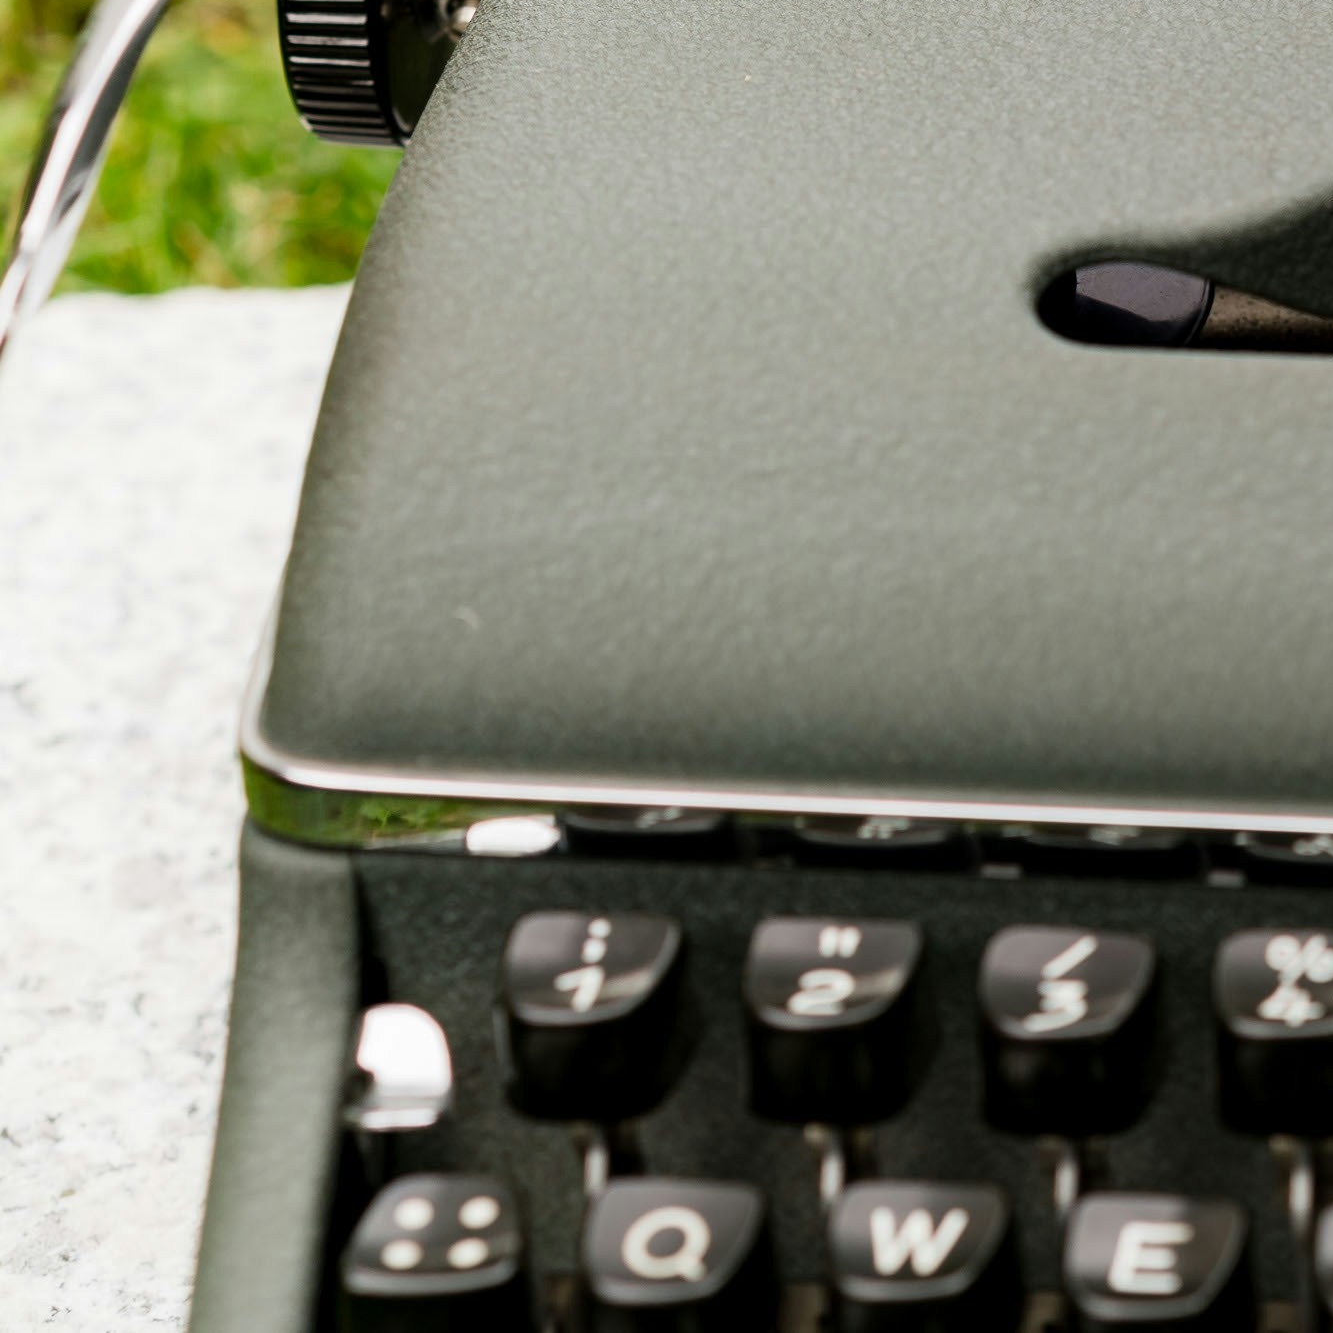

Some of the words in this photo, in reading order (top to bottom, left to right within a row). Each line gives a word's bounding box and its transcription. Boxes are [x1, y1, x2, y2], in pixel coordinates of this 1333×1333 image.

[554, 965, 605, 1013] 1
[788, 968, 856, 1016] 2
[1022, 979, 1088, 1033] 3
[1257, 985, 1325, 1027] 4
[621, 1206, 711, 1282] Q
[869, 1206, 969, 1276] W
[1107, 1220, 1194, 1296] E
